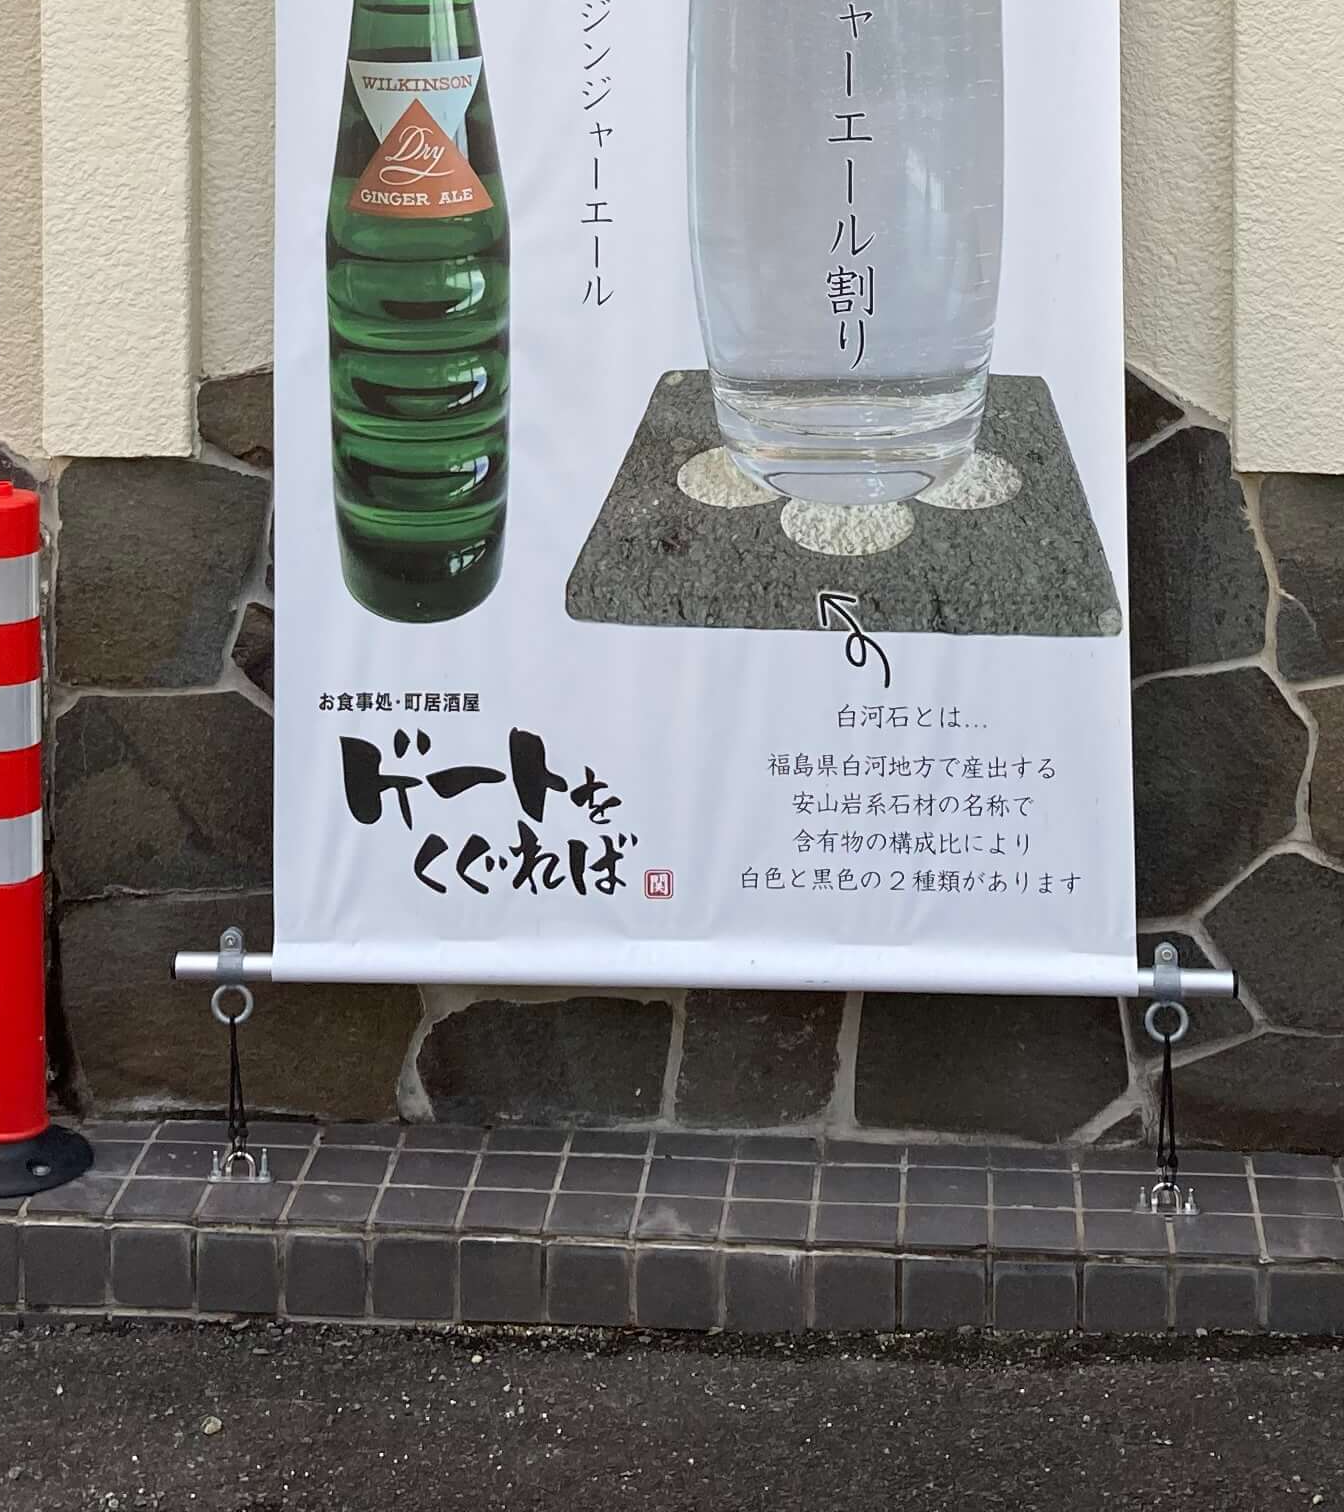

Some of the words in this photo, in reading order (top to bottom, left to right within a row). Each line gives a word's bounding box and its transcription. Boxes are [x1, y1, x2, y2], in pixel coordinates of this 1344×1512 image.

[361, 75, 473, 92] WILKINSON
[379, 125, 456, 186] Dry
[580, 0, 615, 307] ジンジャーエール
[360, 188, 431, 207] GINGER
[438, 188, 473, 205] ALE
[767, 752, 1058, 780] 福島県白河地方で産出する
[792, 791, 1034, 817] 安山岩系石材の名称で
[792, 828, 1030, 856] 含有物の構成比により
[414, 820, 638, 895] くぐれば
